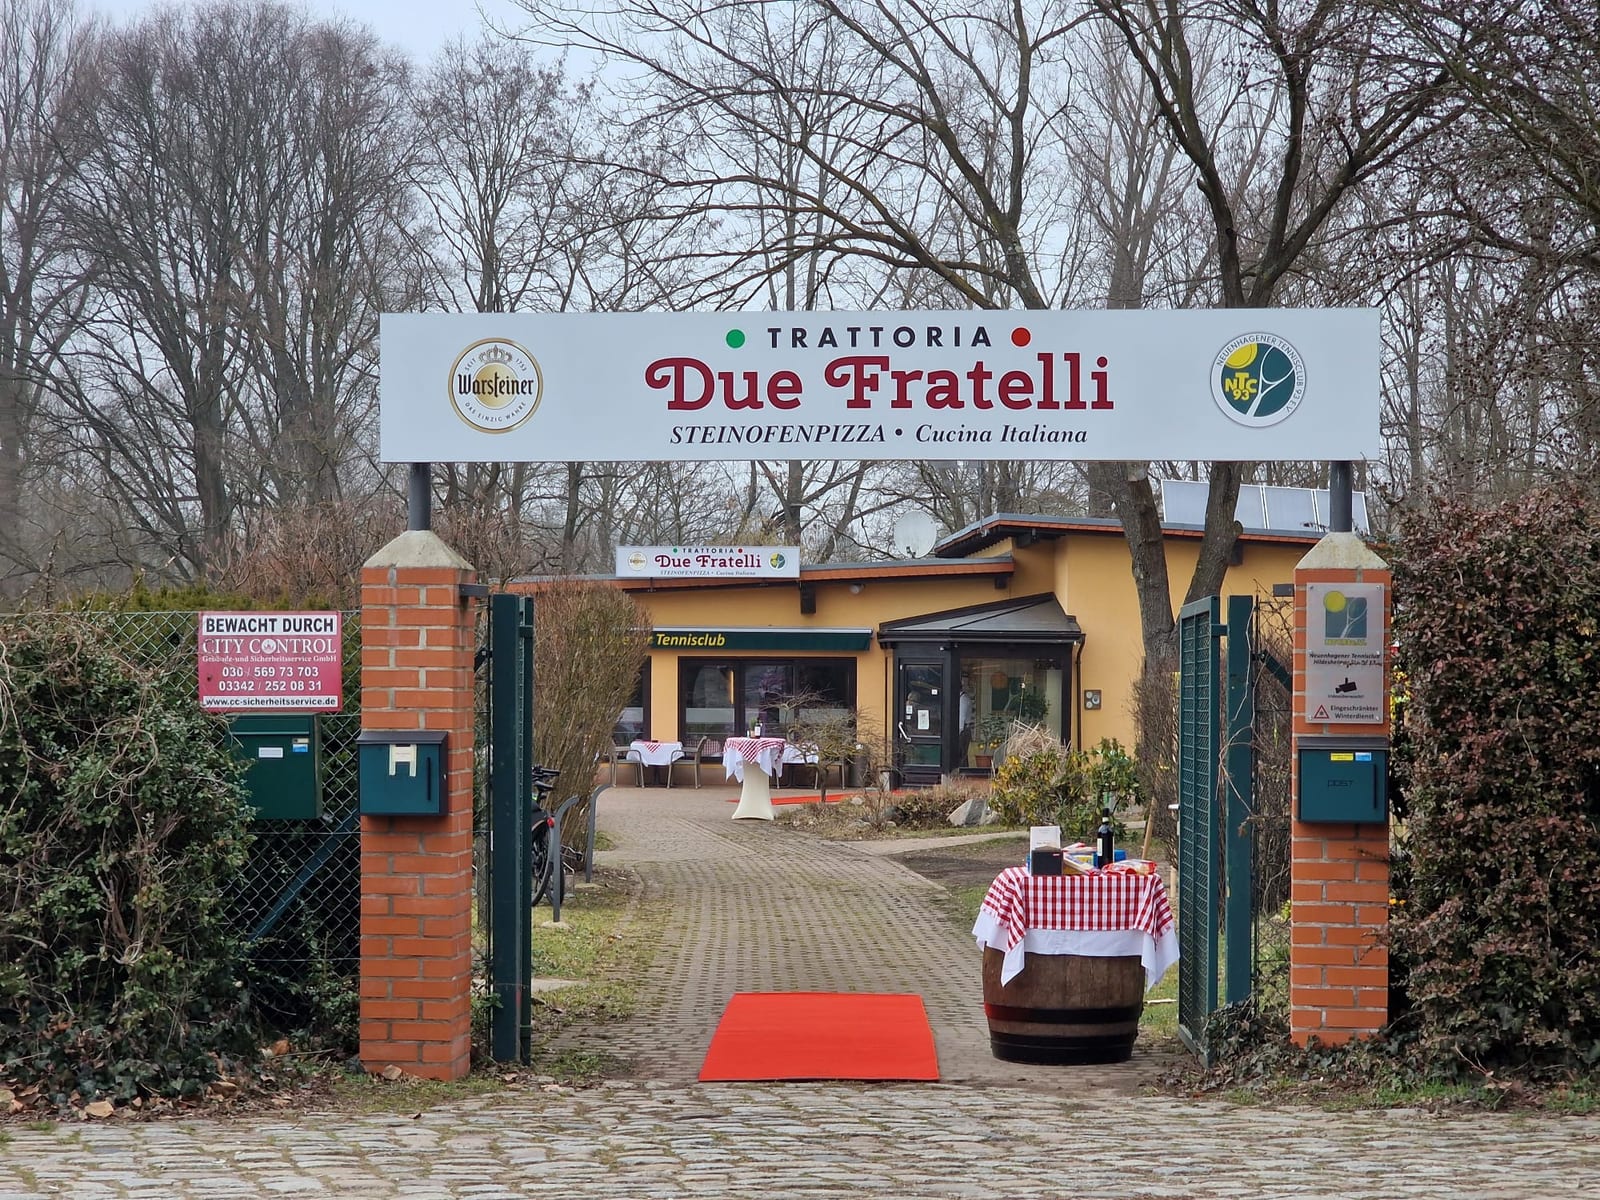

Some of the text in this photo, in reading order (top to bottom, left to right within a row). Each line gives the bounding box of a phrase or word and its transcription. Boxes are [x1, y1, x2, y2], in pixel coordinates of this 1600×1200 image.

[768, 326, 992, 349] TRATTORIA
[464, 357, 527, 372] SEIT 1753
[1216, 334, 1277, 367] NEUENHAGENER
[1278, 340, 1304, 387] TENNISCLUB
[458, 371, 534, 398] Warsteiner
[644, 352, 1114, 410] Due Fratelli
[1224, 371, 1258, 394] NTC
[1233, 389, 1250, 401] 93
[464, 401, 527, 422] DAS EINZIG WAHRE
[670, 424, 1088, 444] STEINOFENPIZZA Cucina Italiana
[654, 554, 691, 568] Due
[695, 554, 762, 568] Fratelli
[206, 617, 334, 633] BEWACHT DURCH
[202, 638, 337, 655] CITY CONTROL
[656, 633, 726, 647] Tennisclub
[313, 655, 337, 663] GmbH
[222, 666, 244, 677] 030
[254, 666, 276, 677] 569
[279, 666, 294, 677] 73
[297, 666, 319, 677] 703
[218, 680, 255, 691] 03342
[265, 680, 287, 691] 252
[290, 680, 305, 691] 08
[308, 680, 322, 691] 31
[205, 696, 336, 706] www.cc-sicherheitsservice.de
